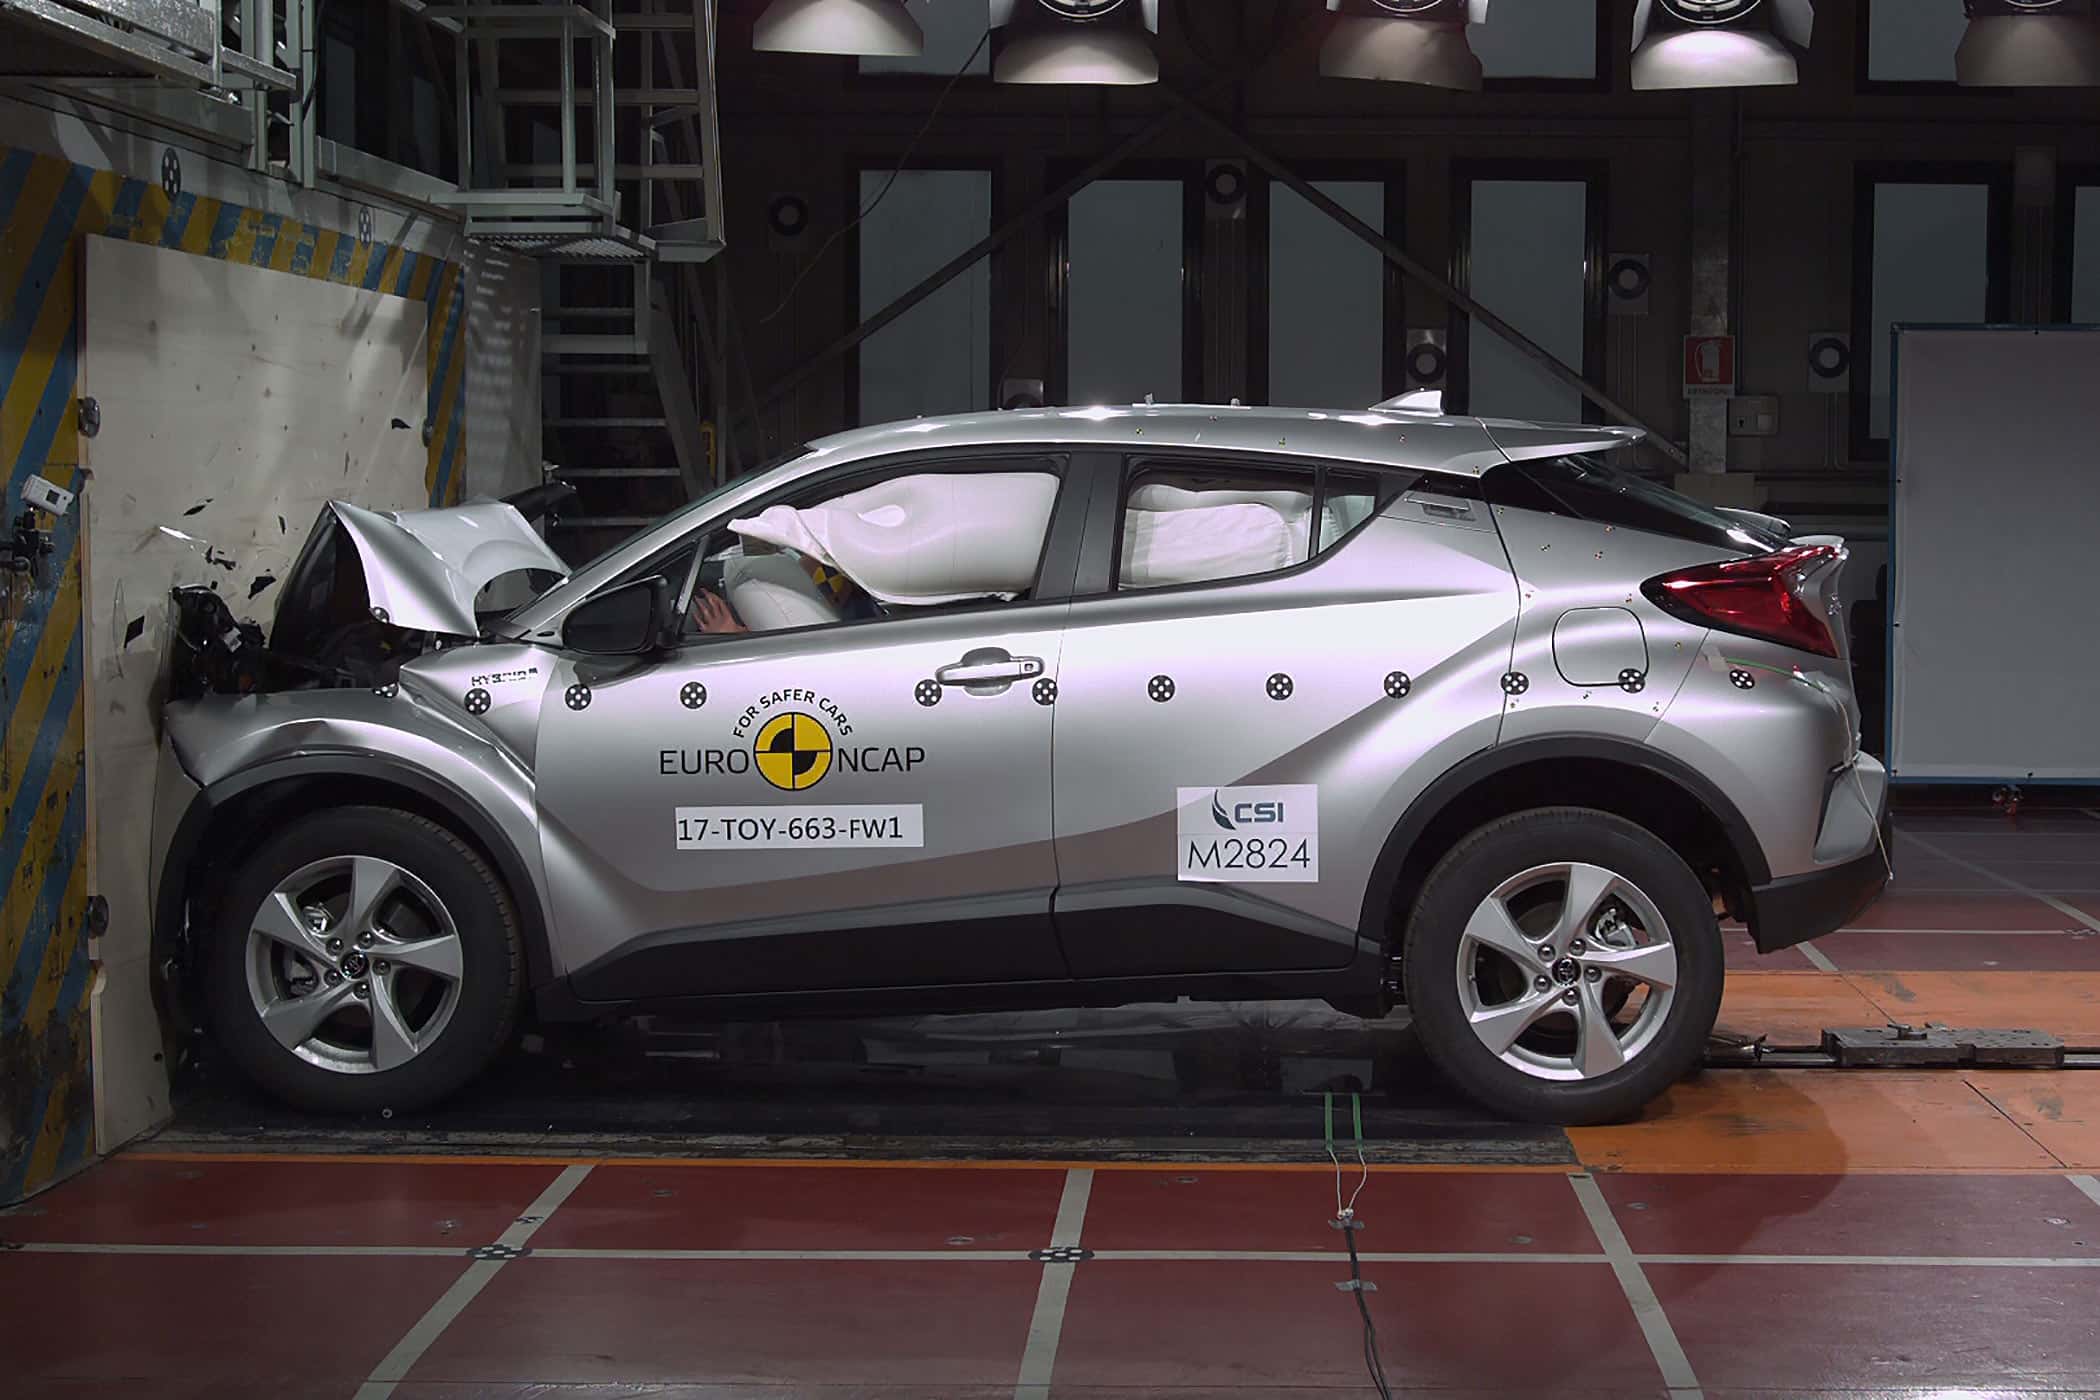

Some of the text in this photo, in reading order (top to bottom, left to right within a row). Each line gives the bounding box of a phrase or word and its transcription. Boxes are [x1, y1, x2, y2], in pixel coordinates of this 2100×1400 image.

[733, 688, 854, 738] FOR SAFER CARS
[659, 746, 926, 775] EURO NCAP
[1234, 802, 1284, 823] CSI
[677, 816, 904, 841] 17-TOY-663-FW1
[1187, 838, 1311, 869] M2824
